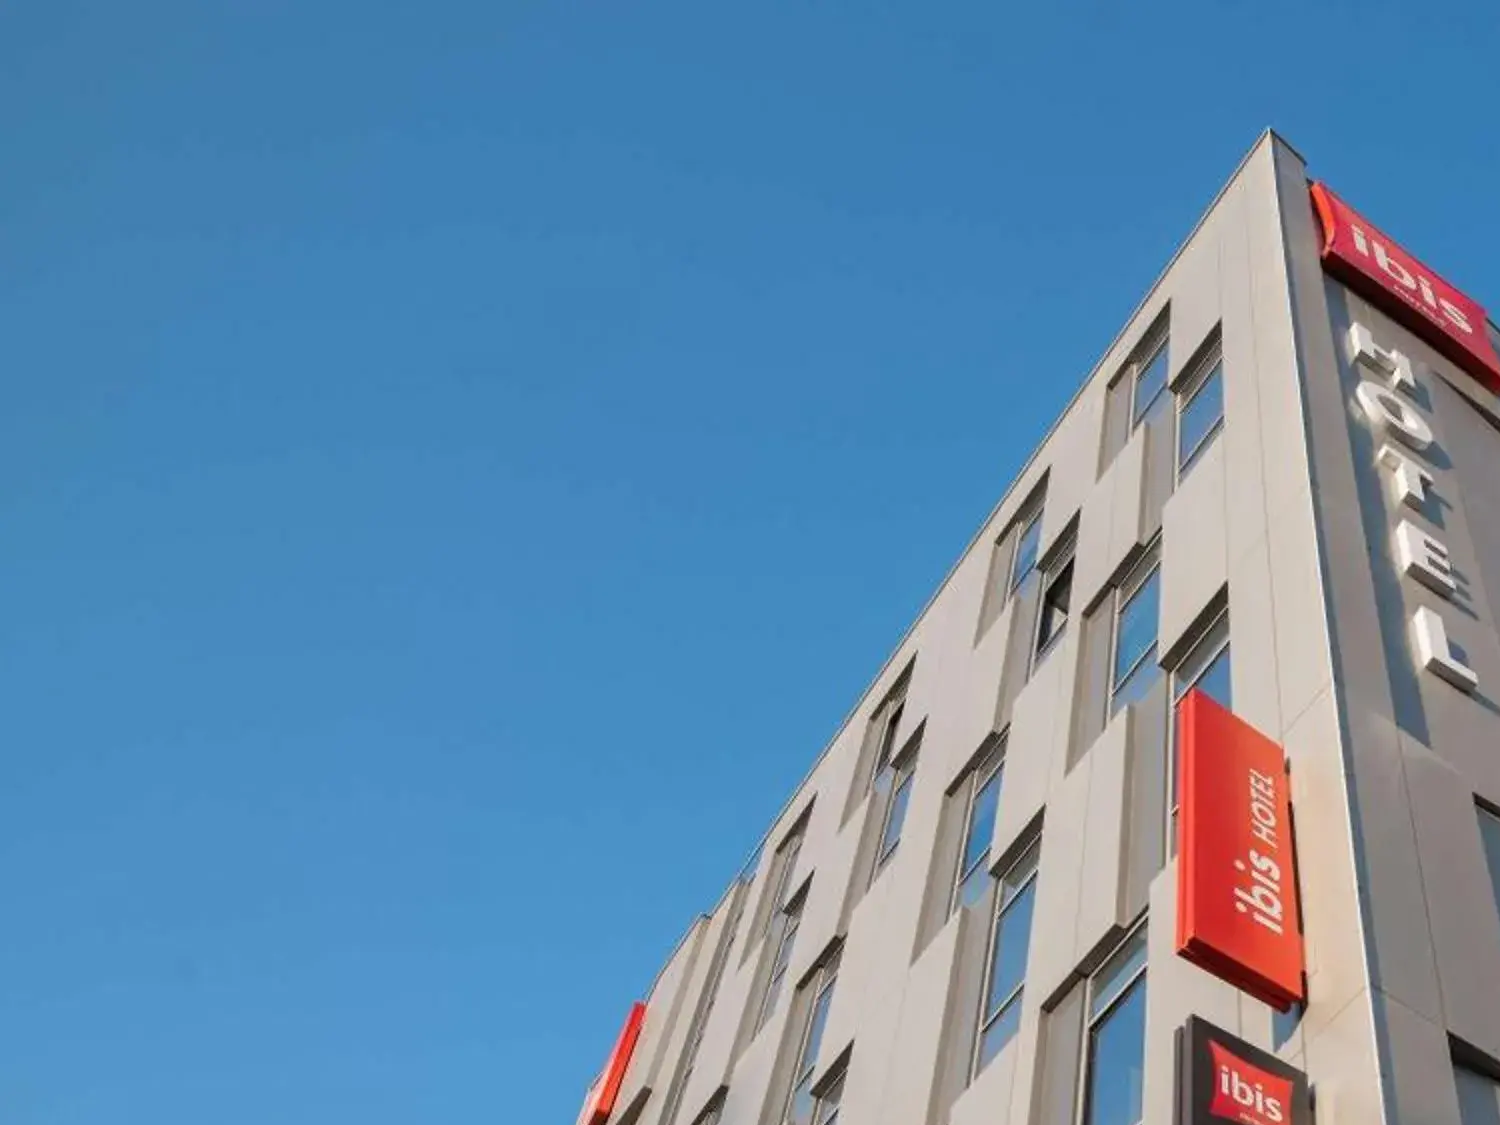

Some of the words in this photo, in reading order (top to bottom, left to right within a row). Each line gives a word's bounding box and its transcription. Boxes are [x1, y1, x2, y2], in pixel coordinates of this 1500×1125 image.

[1351, 223, 1473, 334] ibis
[1350, 320, 1479, 692] HOTEL
[1250, 768, 1279, 849] HOTEL
[1233, 850, 1283, 936] ibis
[1221, 1065, 1283, 1122] ibis
